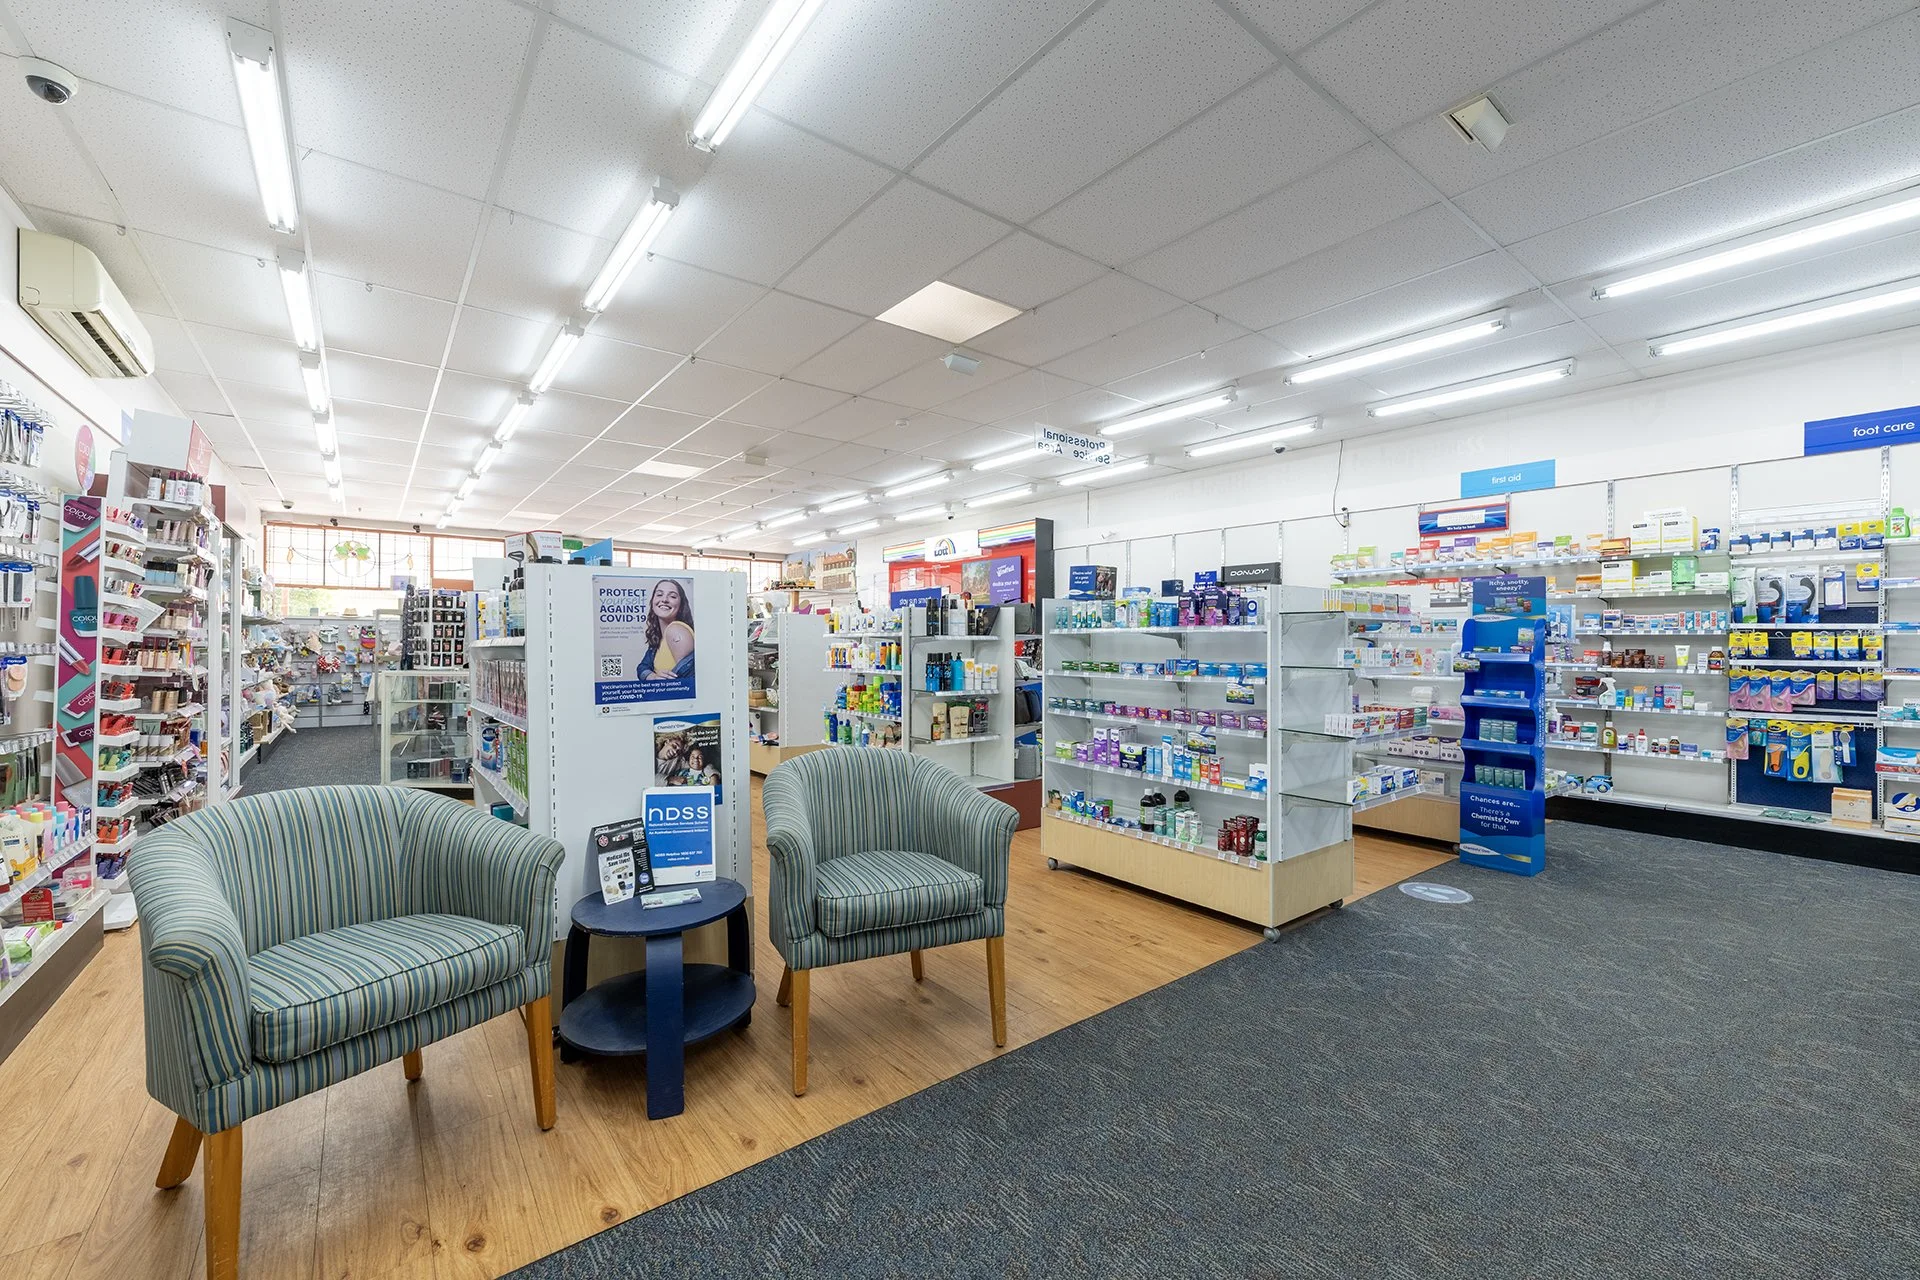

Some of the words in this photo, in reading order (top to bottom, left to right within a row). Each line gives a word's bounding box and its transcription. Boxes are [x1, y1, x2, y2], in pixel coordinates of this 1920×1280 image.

[1853, 425, 1879, 437] foot
[1883, 422, 1915, 432] care
[1492, 475, 1506, 484] first
[1508, 473, 1521, 482] aid
[1230, 568, 1268, 576] DONJOY
[600, 588, 646, 597] PROTECT
[600, 597, 646, 606] yourself
[600, 605, 646, 613] AGAINST
[600, 614, 647, 623] COVID-19
[1470, 795, 1500, 805] Chances
[1480, 806, 1504, 816] There's
[1471, 812, 1503, 822] Chemists'
[1492, 823, 1508, 831] that.
